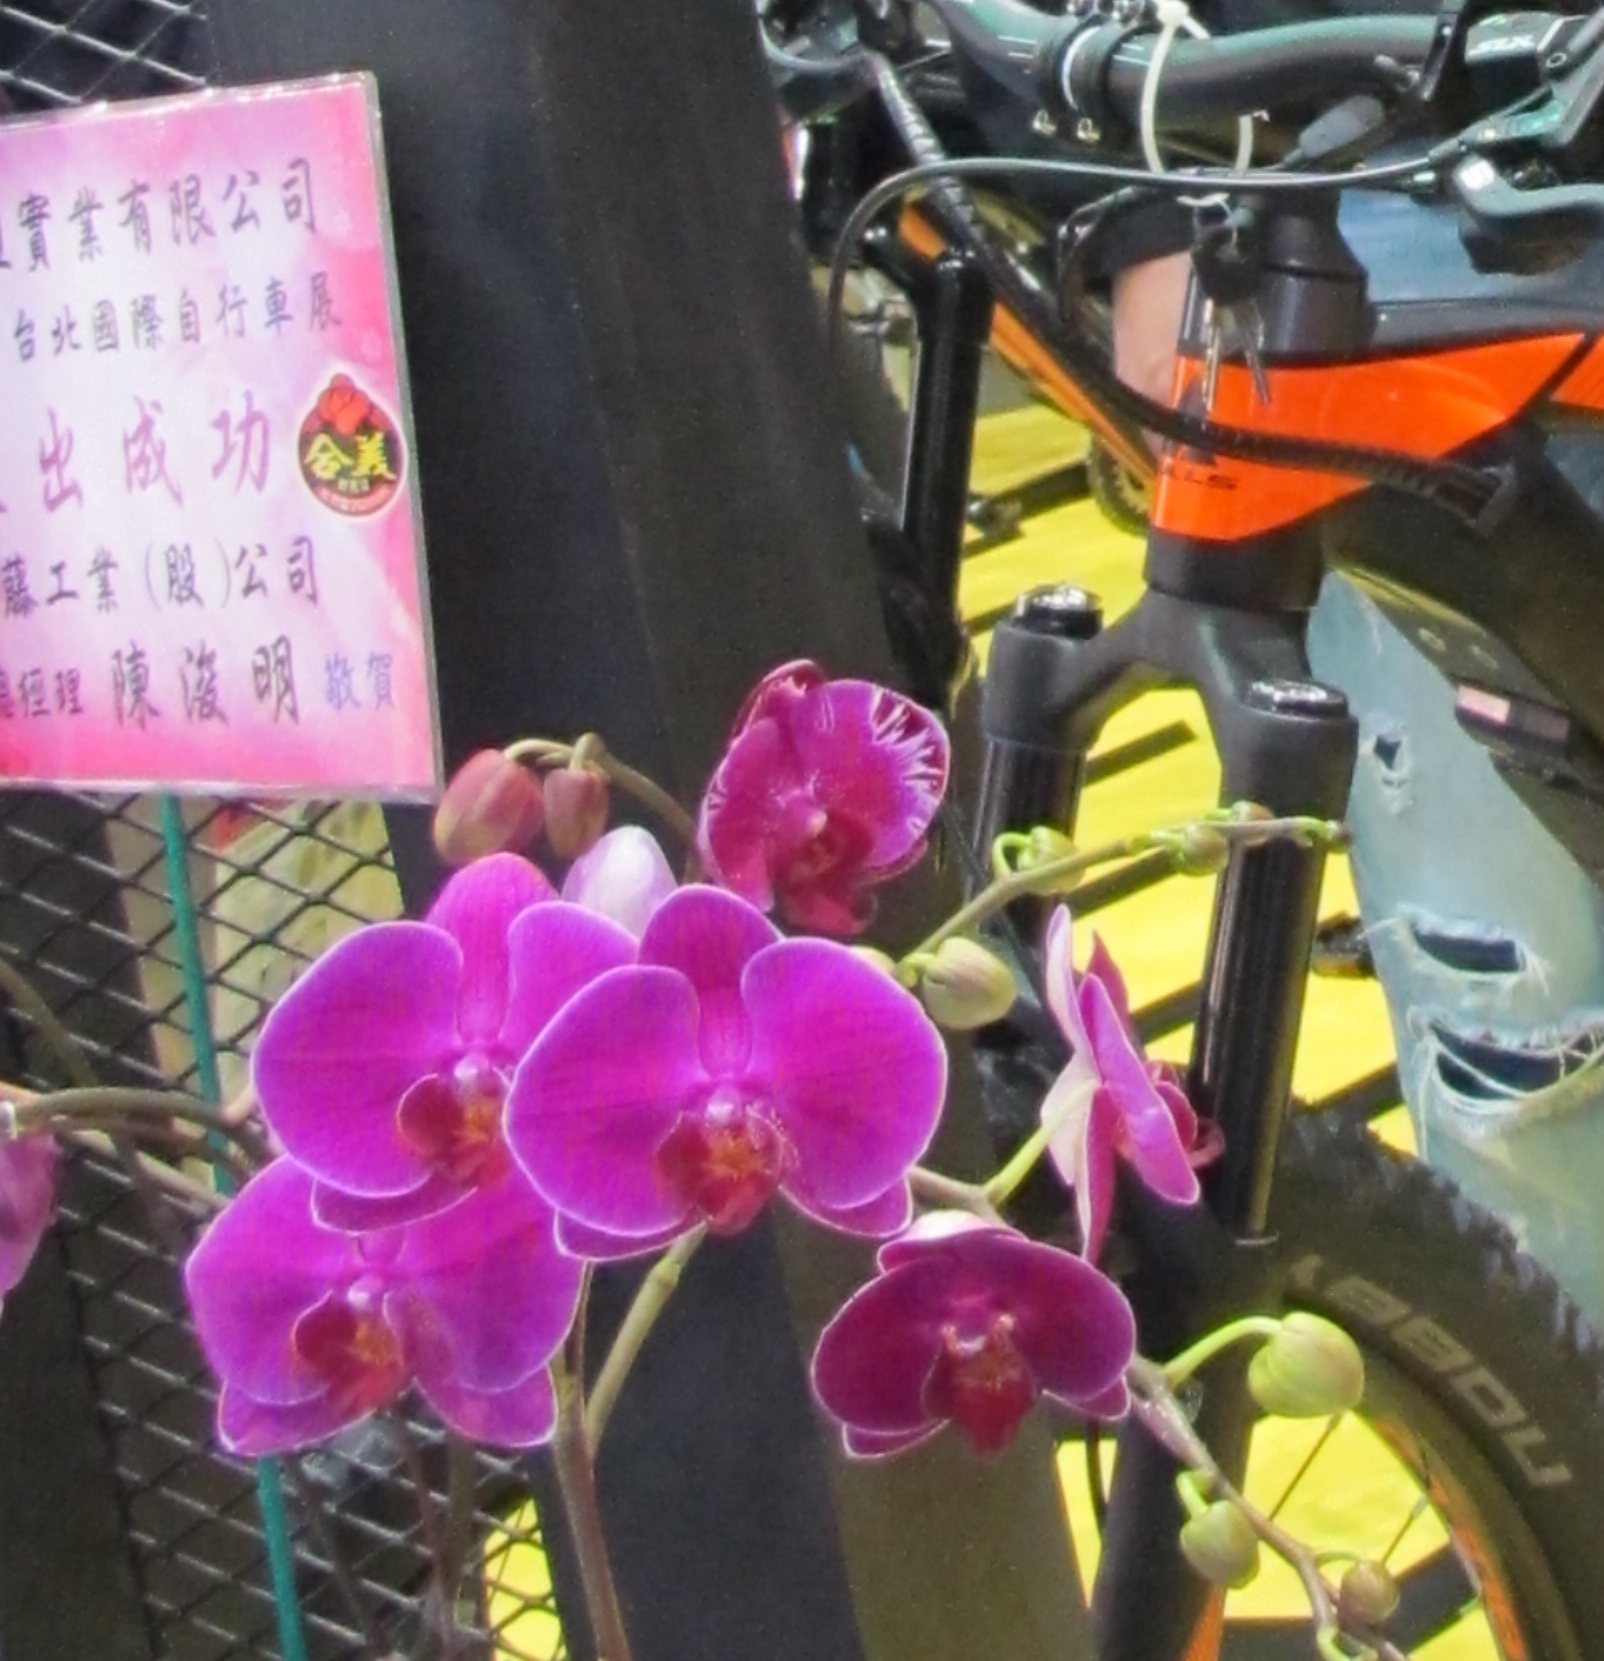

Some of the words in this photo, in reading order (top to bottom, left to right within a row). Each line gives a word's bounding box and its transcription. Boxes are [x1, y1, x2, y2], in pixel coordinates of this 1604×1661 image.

[0, 157, 316, 272] 實業有限公司
[0, 388, 270, 514] 出成功
